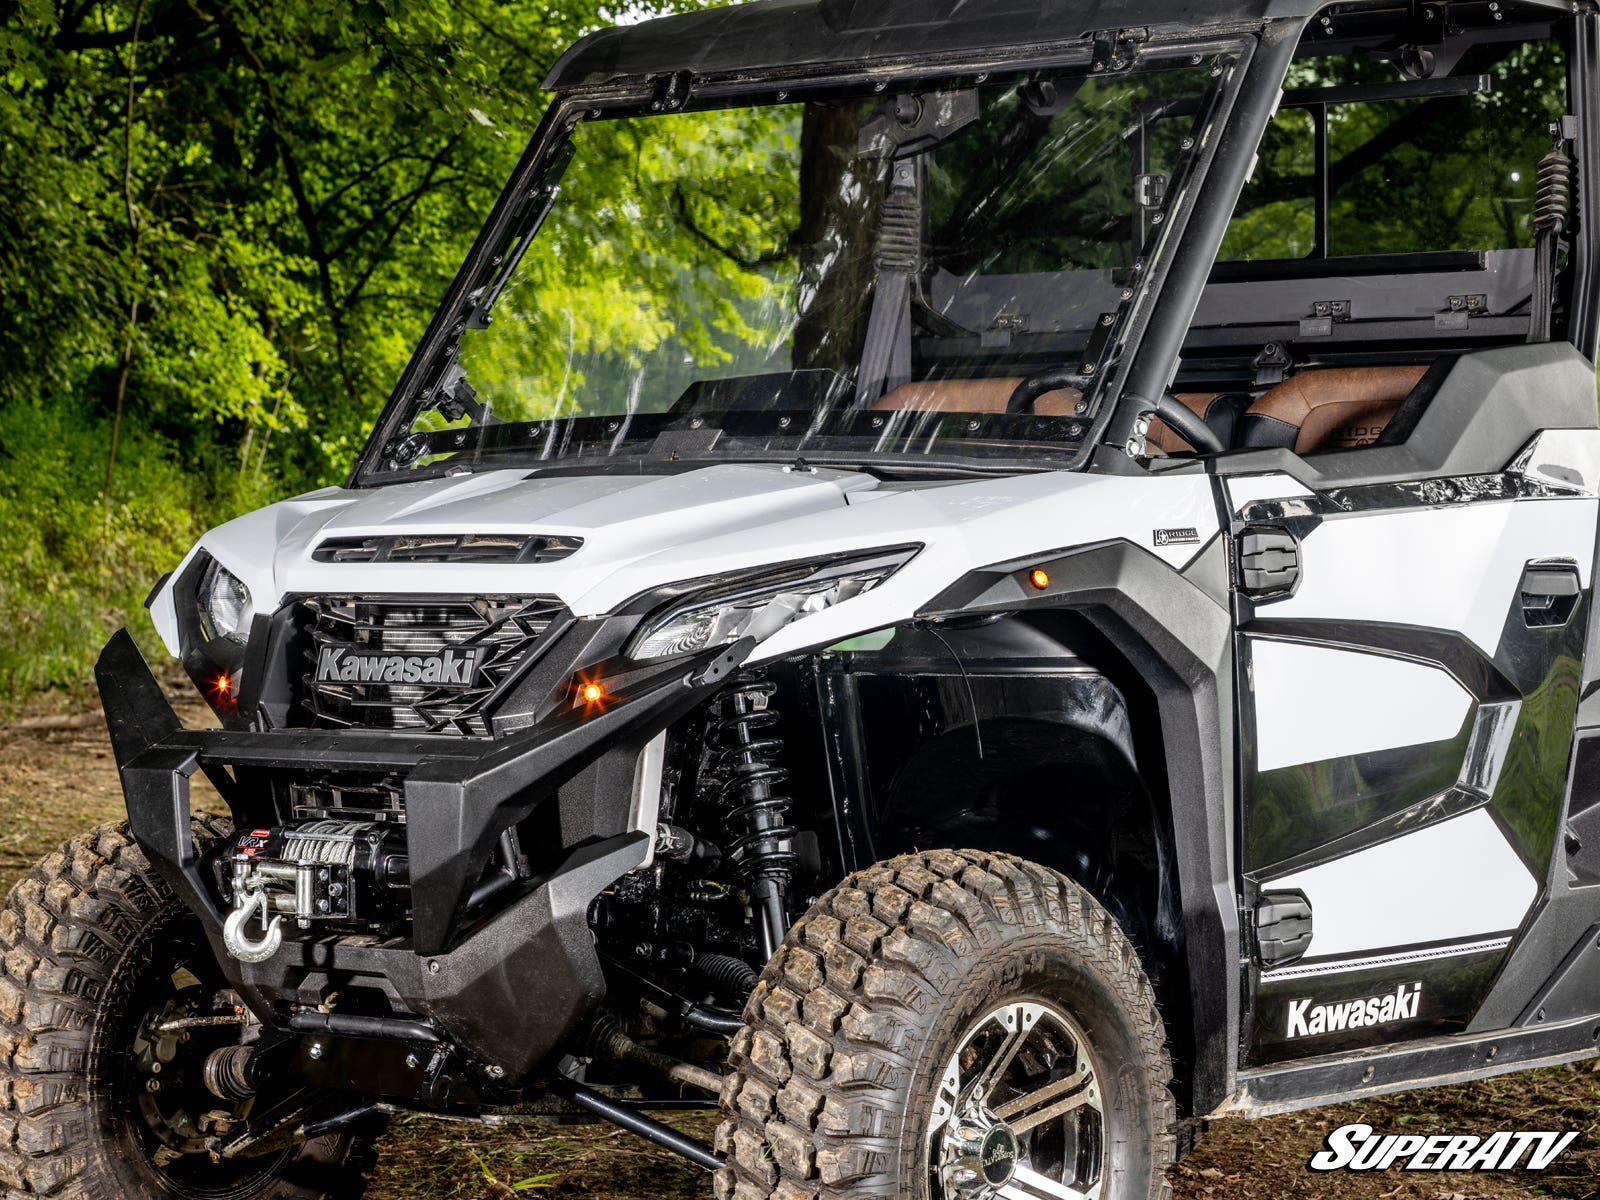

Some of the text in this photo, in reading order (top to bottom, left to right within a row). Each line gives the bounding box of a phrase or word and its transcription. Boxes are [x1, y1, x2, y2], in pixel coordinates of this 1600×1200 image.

[1168, 529, 1197, 538] RIDGE
[318, 648, 476, 684] Kawasaki
[1286, 981, 1422, 1039] Kawasaki
